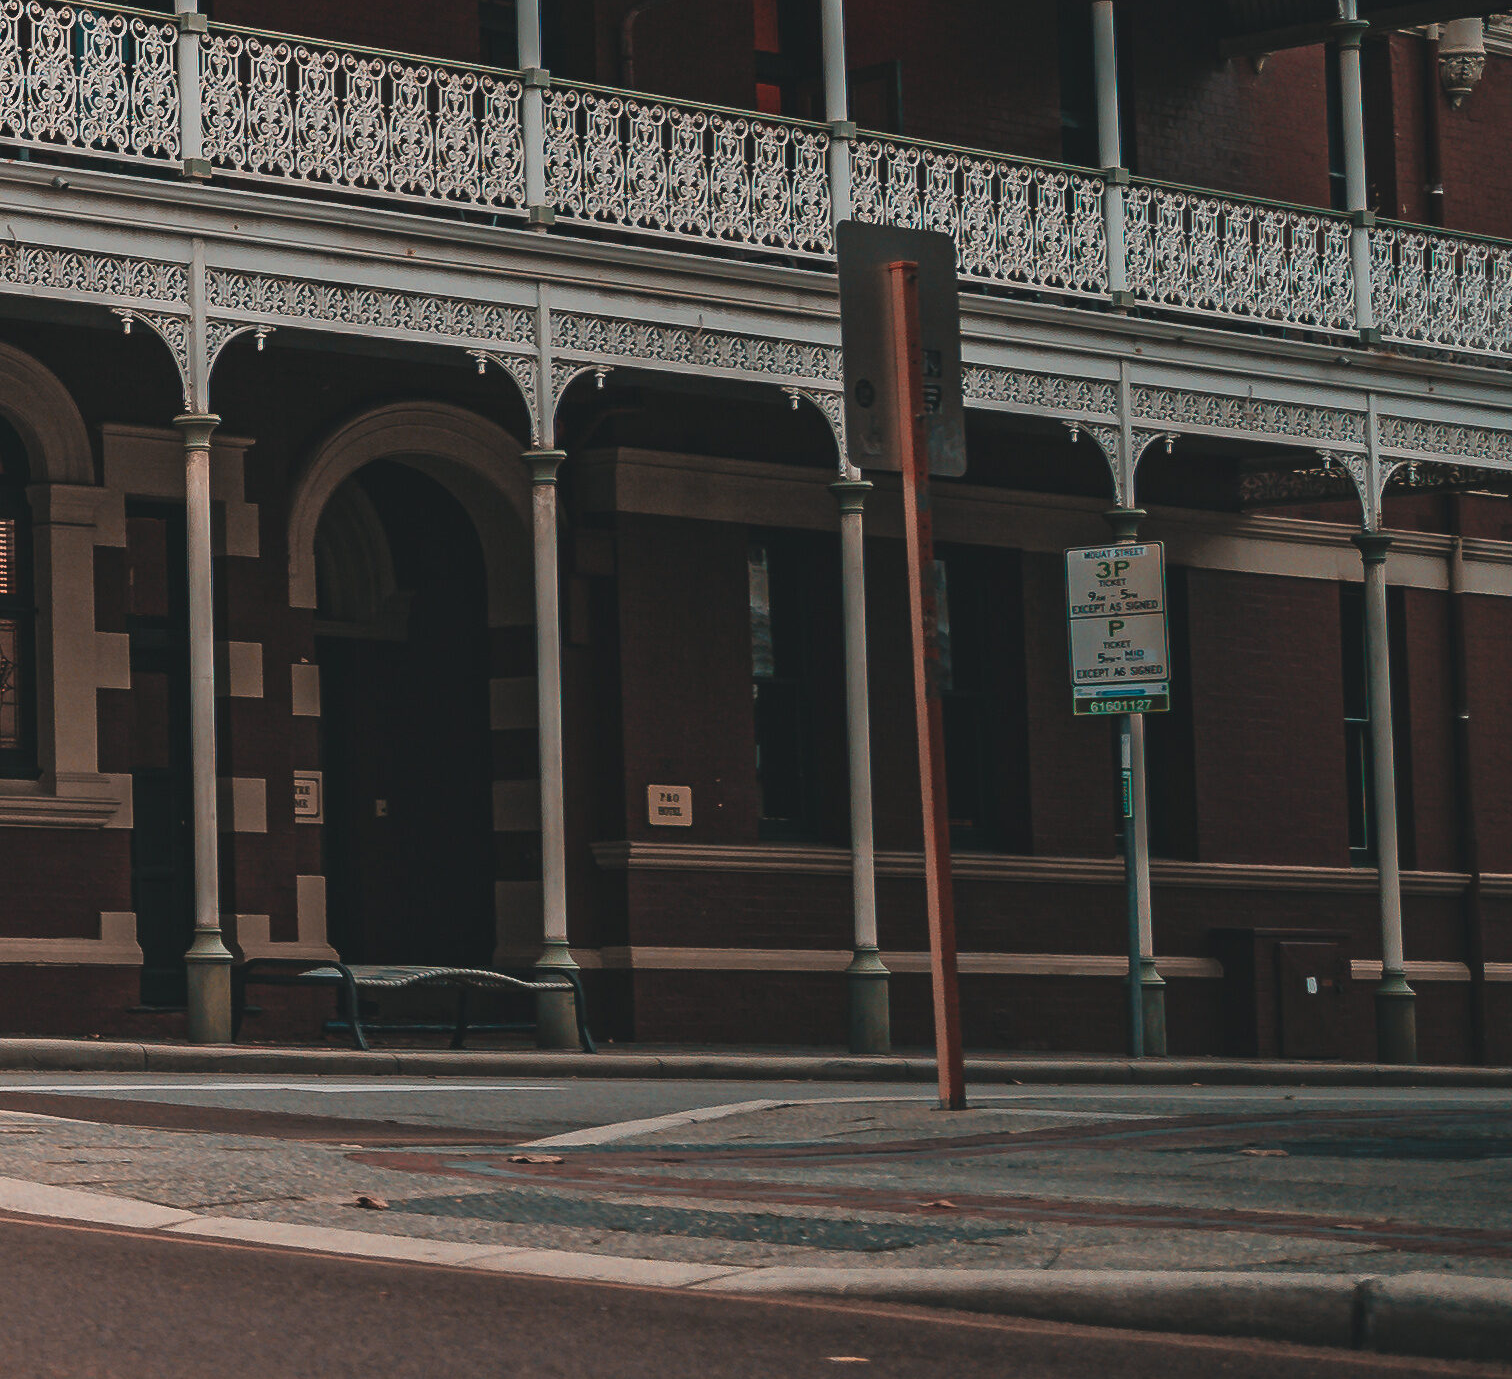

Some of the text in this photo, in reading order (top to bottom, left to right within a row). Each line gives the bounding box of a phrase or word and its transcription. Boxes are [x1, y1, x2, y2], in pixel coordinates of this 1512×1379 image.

[1084, 547, 1144, 559] MOUAT STREET
[1096, 561, 1130, 579] 3P
[1099, 578, 1126, 587] TICKET
[1120, 589, 1138, 599] 5PM
[1072, 600, 1158, 614] EXCEPT AS SIGNED
[1108, 620, 1125, 637] P
[1103, 640, 1131, 649] TICKET
[1125, 649, 1144, 657] MID
[1077, 665, 1163, 679] EXCEPT AS SIGNED
